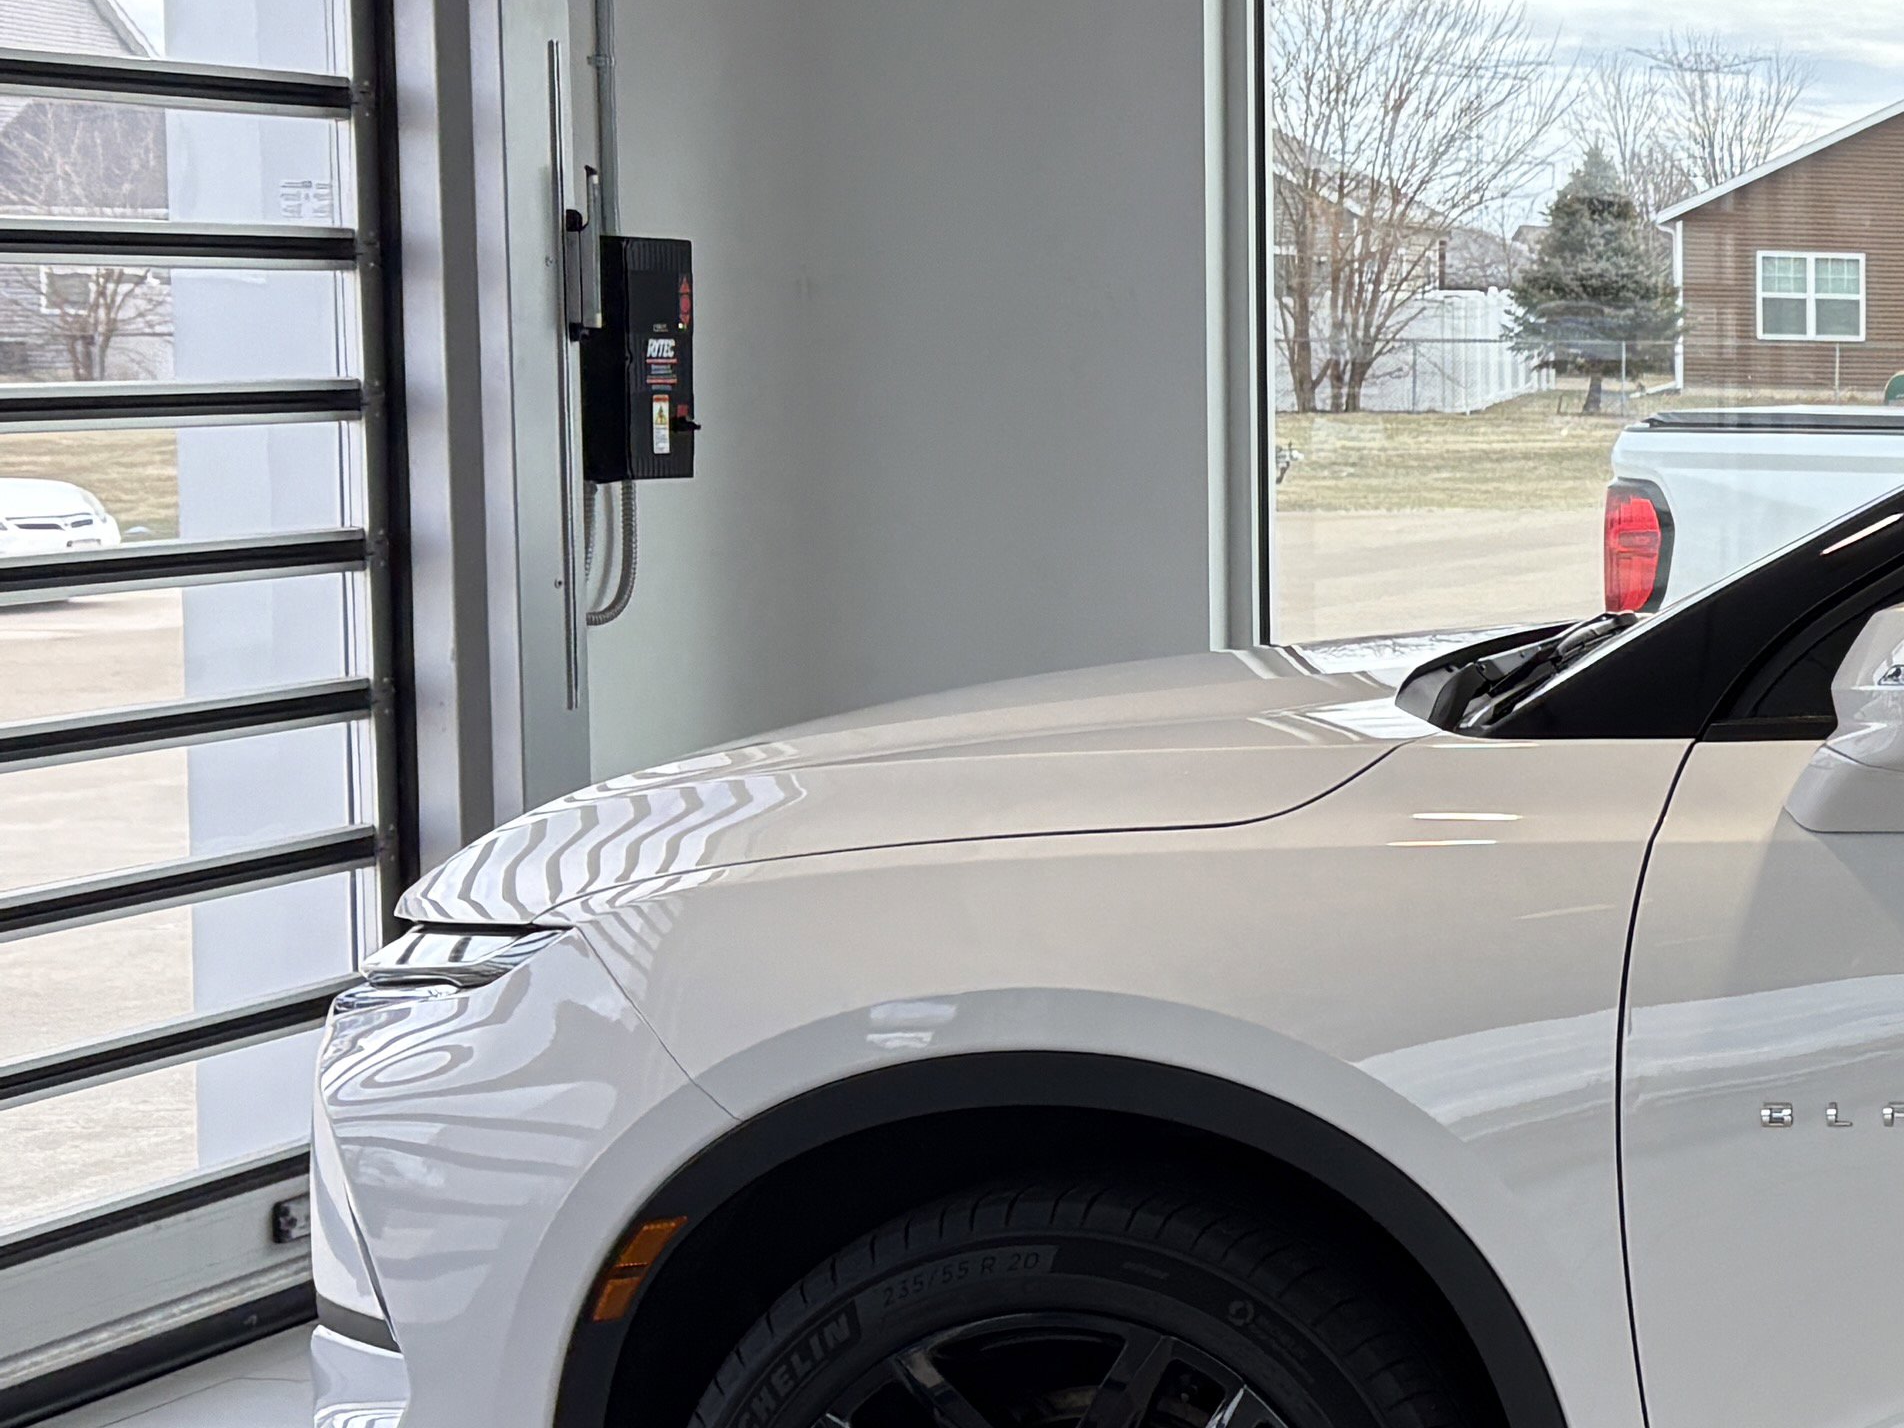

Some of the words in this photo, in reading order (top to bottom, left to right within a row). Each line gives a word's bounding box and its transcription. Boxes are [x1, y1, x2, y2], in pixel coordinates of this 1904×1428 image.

[646, 338, 676, 358] RYTEC
[881, 1261, 970, 1308] 235/55
[981, 1256, 995, 1275] R
[1009, 1253, 1039, 1272] 20
